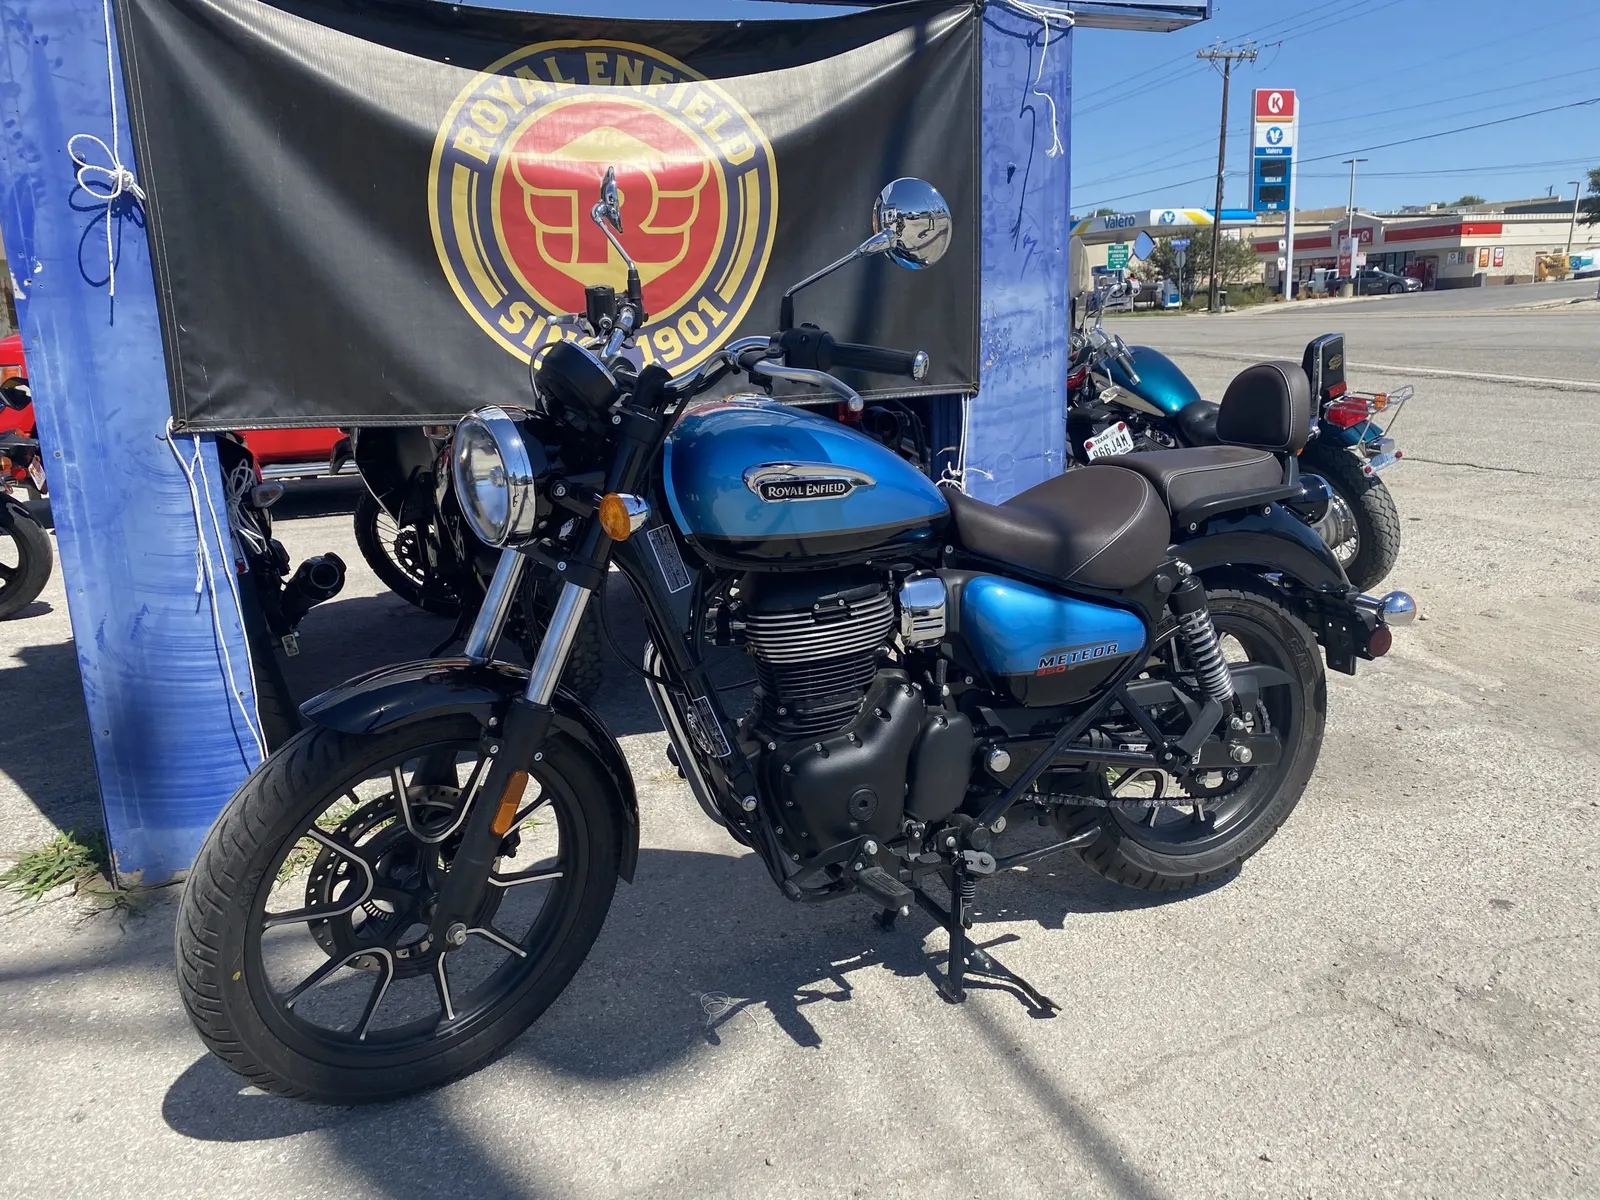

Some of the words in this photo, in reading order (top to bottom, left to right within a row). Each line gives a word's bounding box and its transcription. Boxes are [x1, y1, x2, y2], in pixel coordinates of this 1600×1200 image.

[452, 57, 576, 165] ROYAL
[584, 51, 758, 166] ENFIELD
[1104, 214, 1135, 229] Valero
[636, 296, 727, 368] 1901
[1094, 433, 1109, 445] TEXAS
[767, 485, 804, 498] ROYAL
[806, 482, 846, 496] ENFIELD
[1037, 642, 1119, 669] METEOR
[1035, 664, 1068, 677] 350
